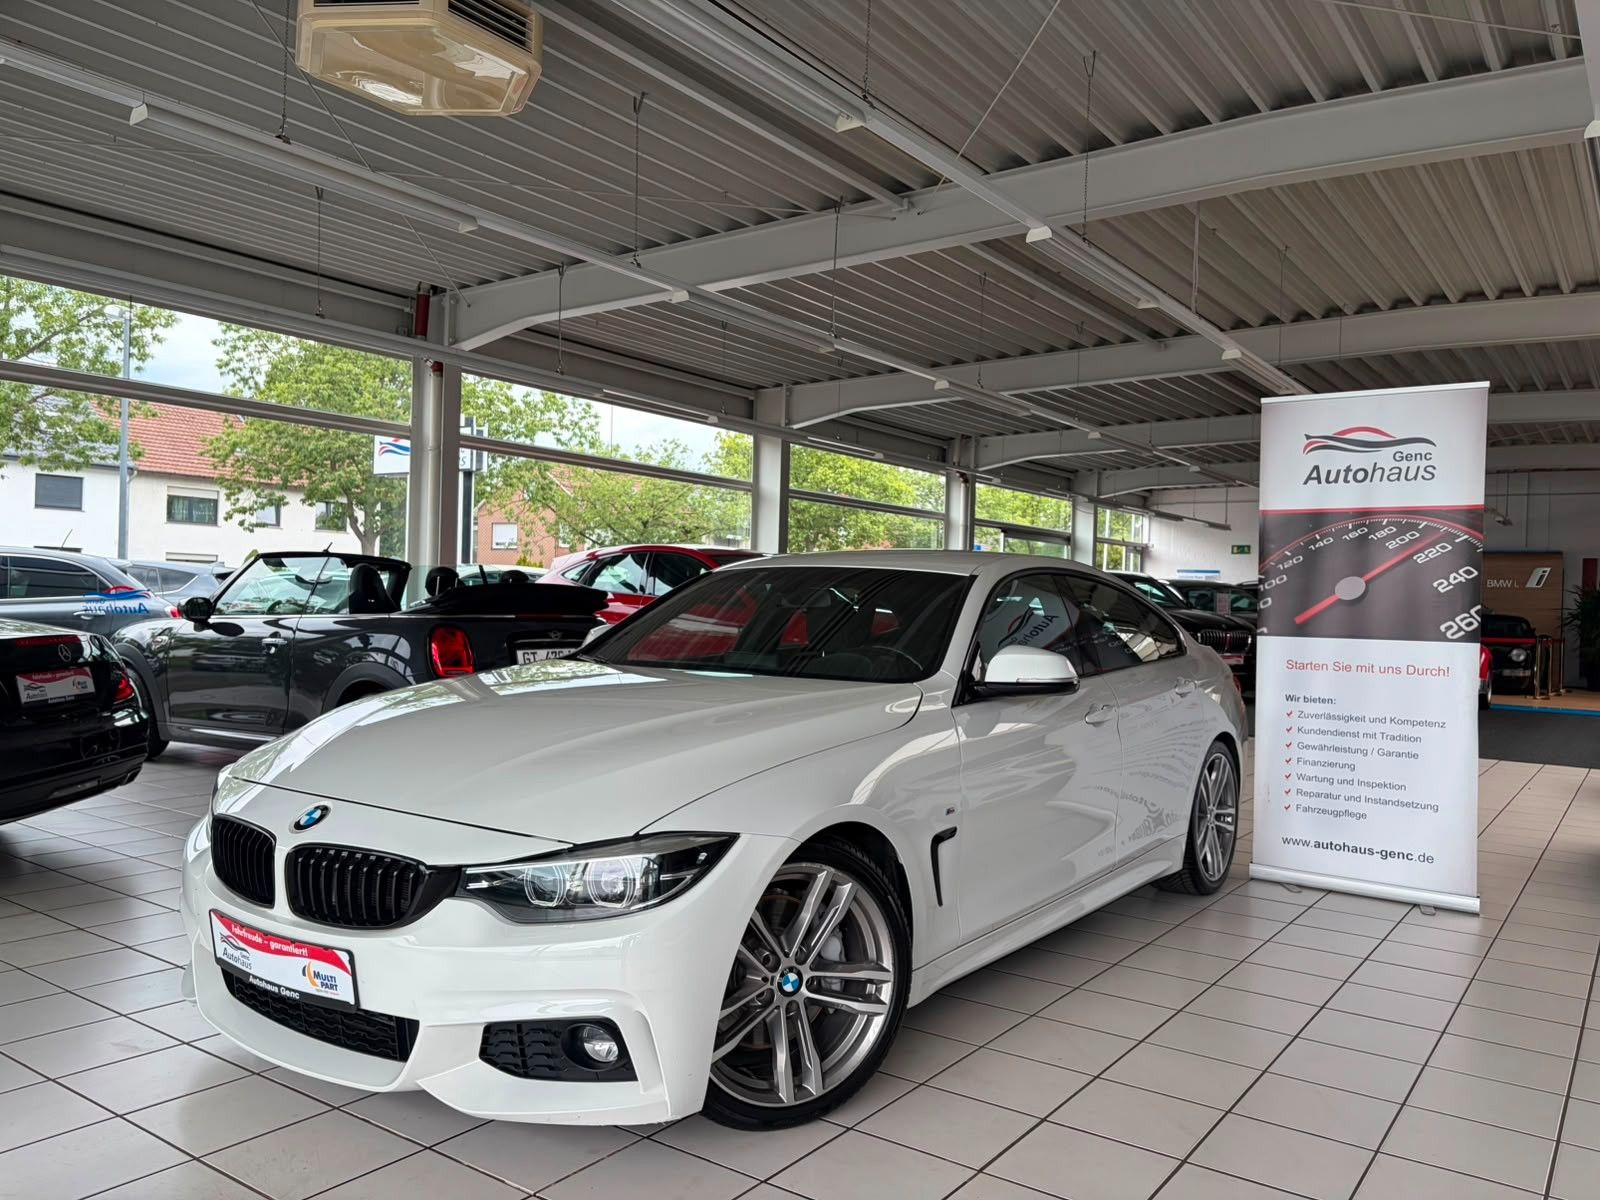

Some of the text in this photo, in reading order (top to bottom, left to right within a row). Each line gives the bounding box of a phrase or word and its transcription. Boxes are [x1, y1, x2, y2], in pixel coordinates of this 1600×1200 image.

[1393, 451, 1432, 462] Genc
[1302, 462, 1436, 485] Autohaus
[1342, 527, 1368, 540] 160
[1368, 526, 1396, 540] 180
[1385, 531, 1420, 549] 200
[1308, 537, 1334, 550] 140
[1413, 543, 1452, 563] 220
[1276, 555, 1303, 570] 120
[1258, 574, 1287, 591] 100
[1433, 566, 1478, 593] 240
[1487, 579, 1512, 588] BMW
[1286, 659, 1450, 677] Starten Sie mit uns Durch!
[1285, 694, 1337, 705] Wir bieten:
[1297, 710, 1447, 729] Zuverlässigkeit und Kompetenz
[1297, 726, 1422, 743] Kundendienst mit Tradition
[1297, 742, 1368, 757] Gewährleistung
[1377, 748, 1419, 760] Garantie
[1296, 757, 1356, 772] Finanzierung
[1296, 773, 1407, 792] Wartung und Inspektion
[1296, 788, 1439, 813] Reparatur und Instandsetzung
[1296, 803, 1367, 820] Fahrzeugpflege
[1282, 836, 1435, 864] www.autohaus-genc.de
[222, 947, 252, 970] Autohaus
[313, 970, 337, 983] MULTI
[249, 975, 279, 992] Autohaus
[280, 986, 300, 999] Genc
[320, 981, 338, 992] PART
